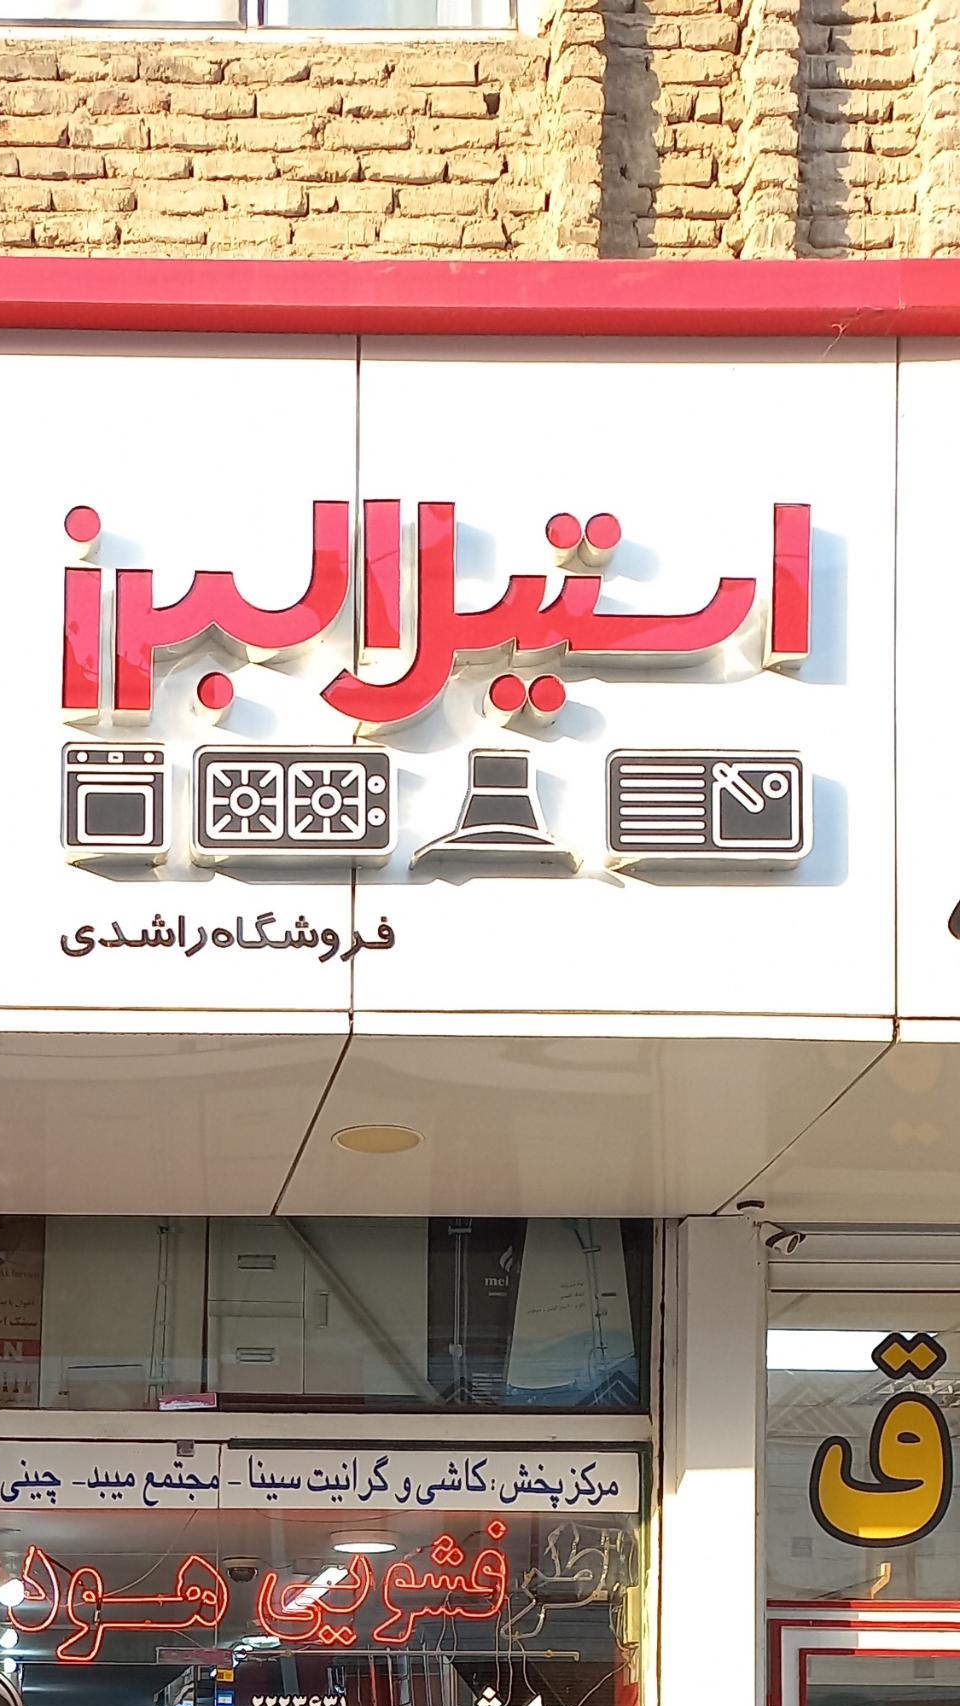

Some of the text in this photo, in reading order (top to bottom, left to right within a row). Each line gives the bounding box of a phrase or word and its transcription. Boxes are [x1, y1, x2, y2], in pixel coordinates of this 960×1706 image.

[61, 911, 395, 963] فروشگاه راشدی
[143, 1461, 220, 1507] مجتمع
[247, 1453, 302, 1500] سینا
[306, 1455, 389, 1503] گرانیت
[394, 1479, 411, 1504] و
[416, 1457, 488, 1505] کاشی
[565, 1460, 620, 1506] مرکز
[7, 1545, 229, 1663] هود
